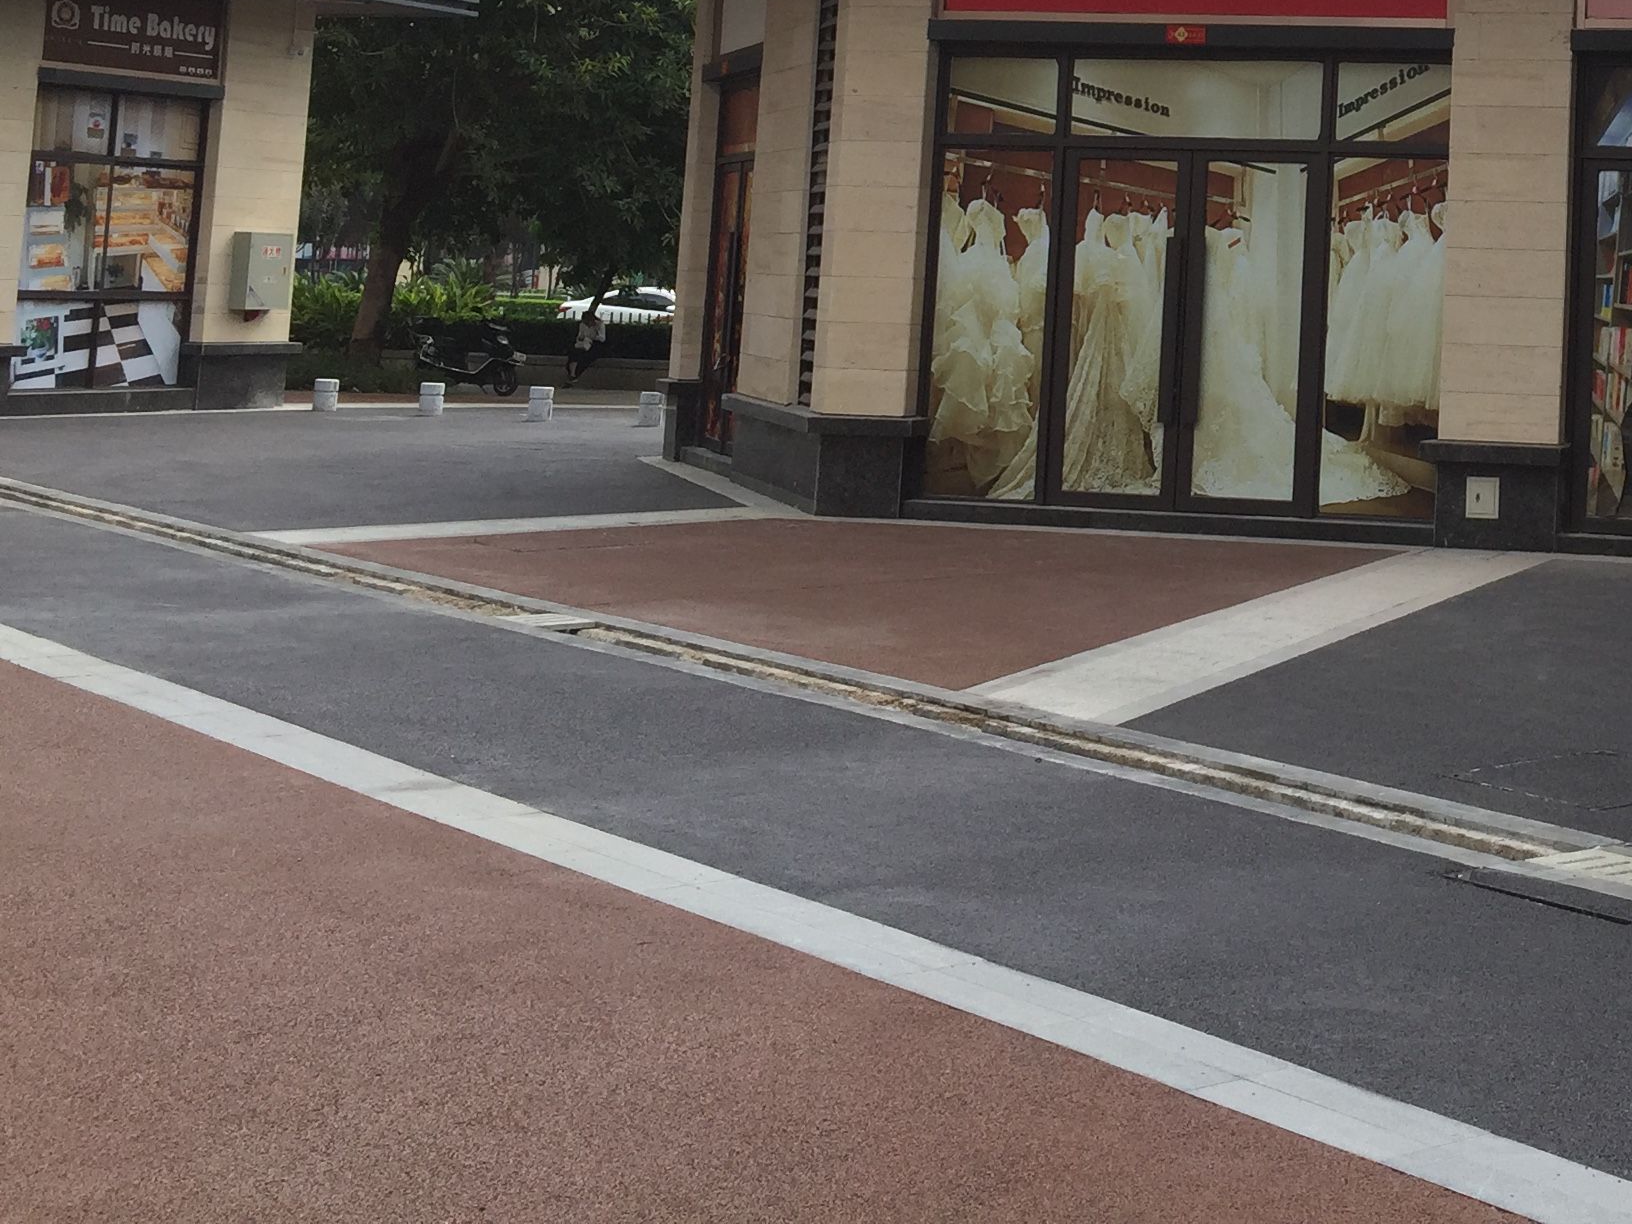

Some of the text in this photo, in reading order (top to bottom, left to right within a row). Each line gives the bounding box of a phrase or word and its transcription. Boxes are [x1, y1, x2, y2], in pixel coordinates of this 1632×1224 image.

[90, 4, 216, 51] Time Bakery
[1071, 75, 1170, 117] Impression
